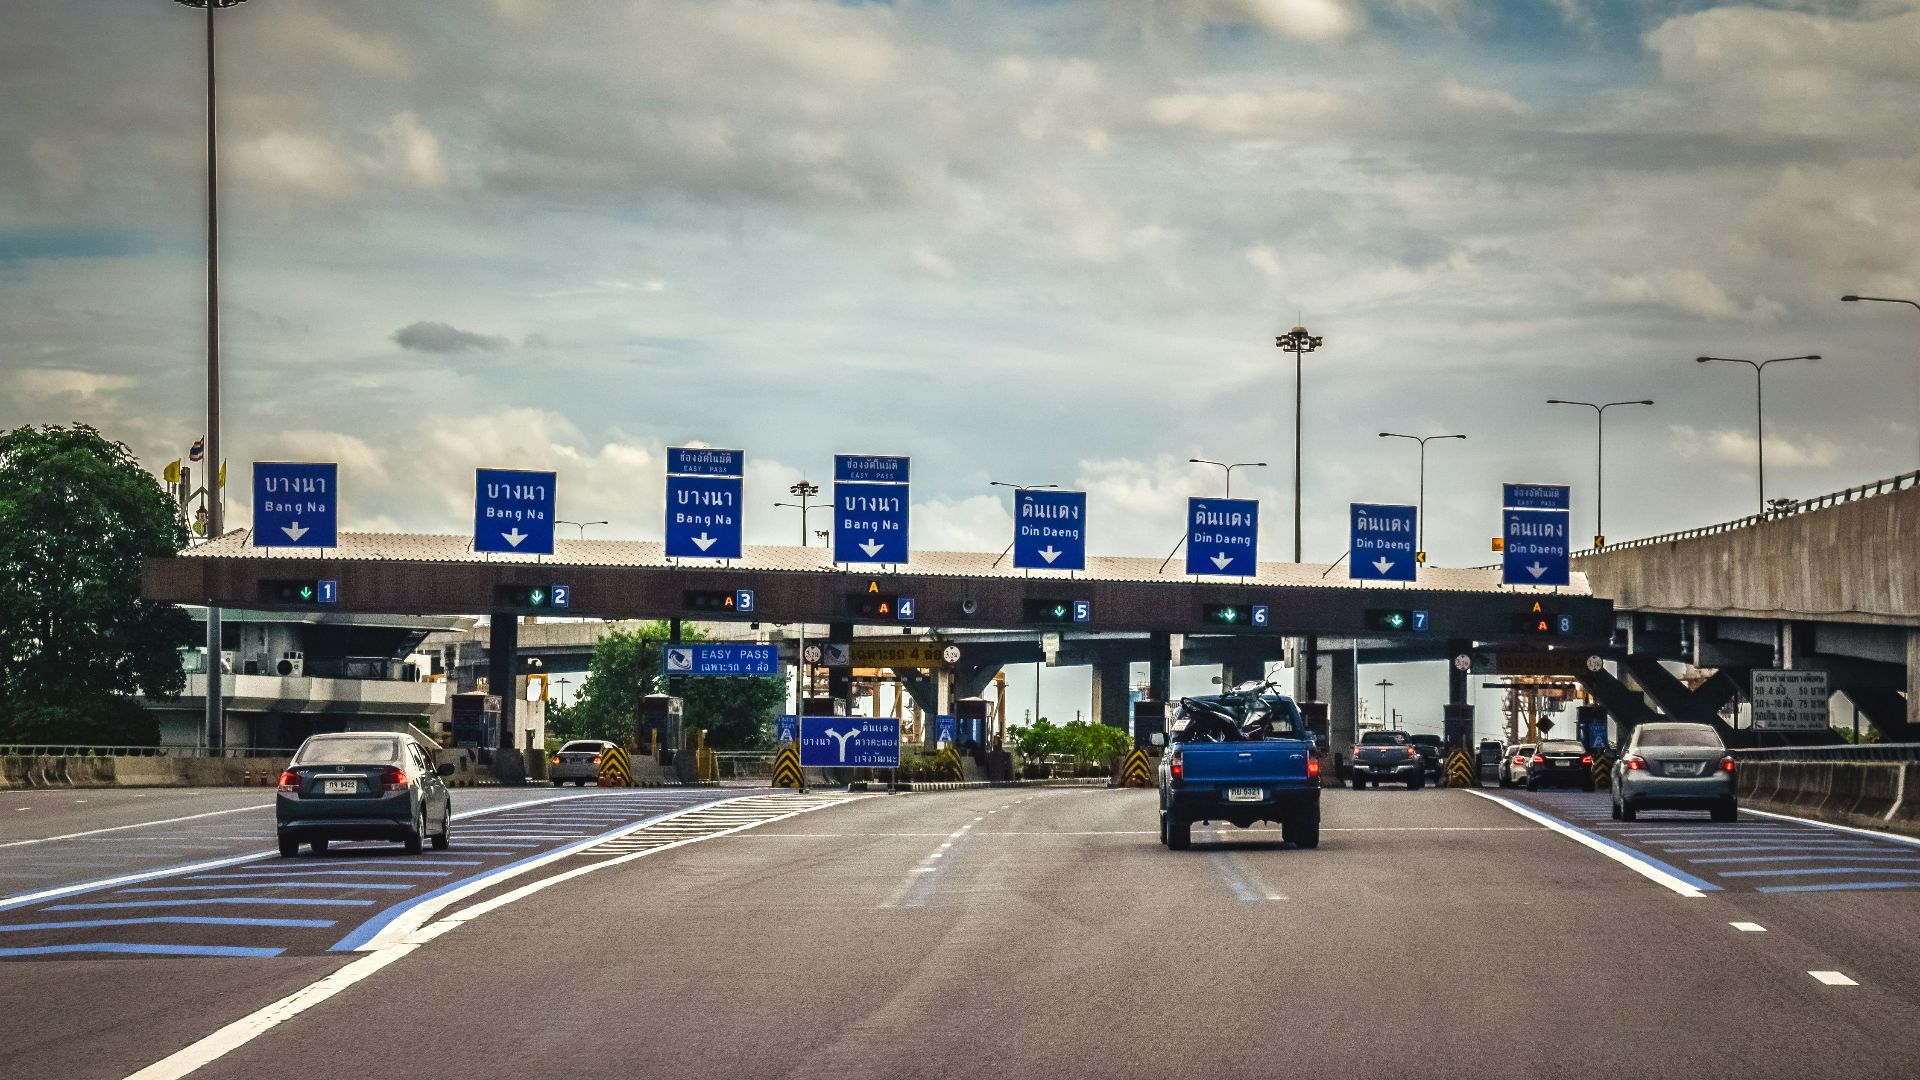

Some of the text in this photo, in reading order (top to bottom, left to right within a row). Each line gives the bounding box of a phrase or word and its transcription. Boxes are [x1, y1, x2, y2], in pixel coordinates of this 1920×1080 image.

[876, 472, 894, 480] PASS
[265, 477, 326, 493] บางนา
[487, 483, 545, 501] บางนา
[677, 489, 732, 507] บางนา
[845, 496, 899, 512] บางนา
[265, 501, 325, 515] Bang Na
[486, 507, 544, 522] Bang Na
[1022, 496, 1079, 520] ดินแดง
[1195, 503, 1251, 527] ดินแดง
[676, 513, 732, 527] Bang Na
[844, 519, 899, 533] Bang Na
[1357, 509, 1410, 533] ดินแดง
[1510, 516, 1563, 538] ดินแดง
[1021, 524, 1079, 540] Din Daeng
[1194, 531, 1250, 547] Din Daeng
[1356, 537, 1410, 552] Din Daeng
[1509, 543, 1527, 554] Din
[1529, 545, 1564, 557] Daeng
[323, 583, 331, 599] 1
[868, 581, 879, 593] A
[554, 588, 565, 604] 2
[724, 596, 733, 606] A
[740, 593, 751, 608] 3
[879, 603, 888, 613] A
[900, 601, 912, 616] 4
[1077, 605, 1087, 619] 5
[1532, 602, 1542, 613] A
[1255, 608, 1265, 623] 6
[1415, 614, 1425, 628] 7
[1538, 621, 1548, 631] A
[1561, 618, 1569, 632] 8
[701, 650, 769, 659] EASY PASS
[745, 663, 751, 671] 4
[862, 721, 894, 732] ดินแดง
[803, 738, 831, 746] บางนา
